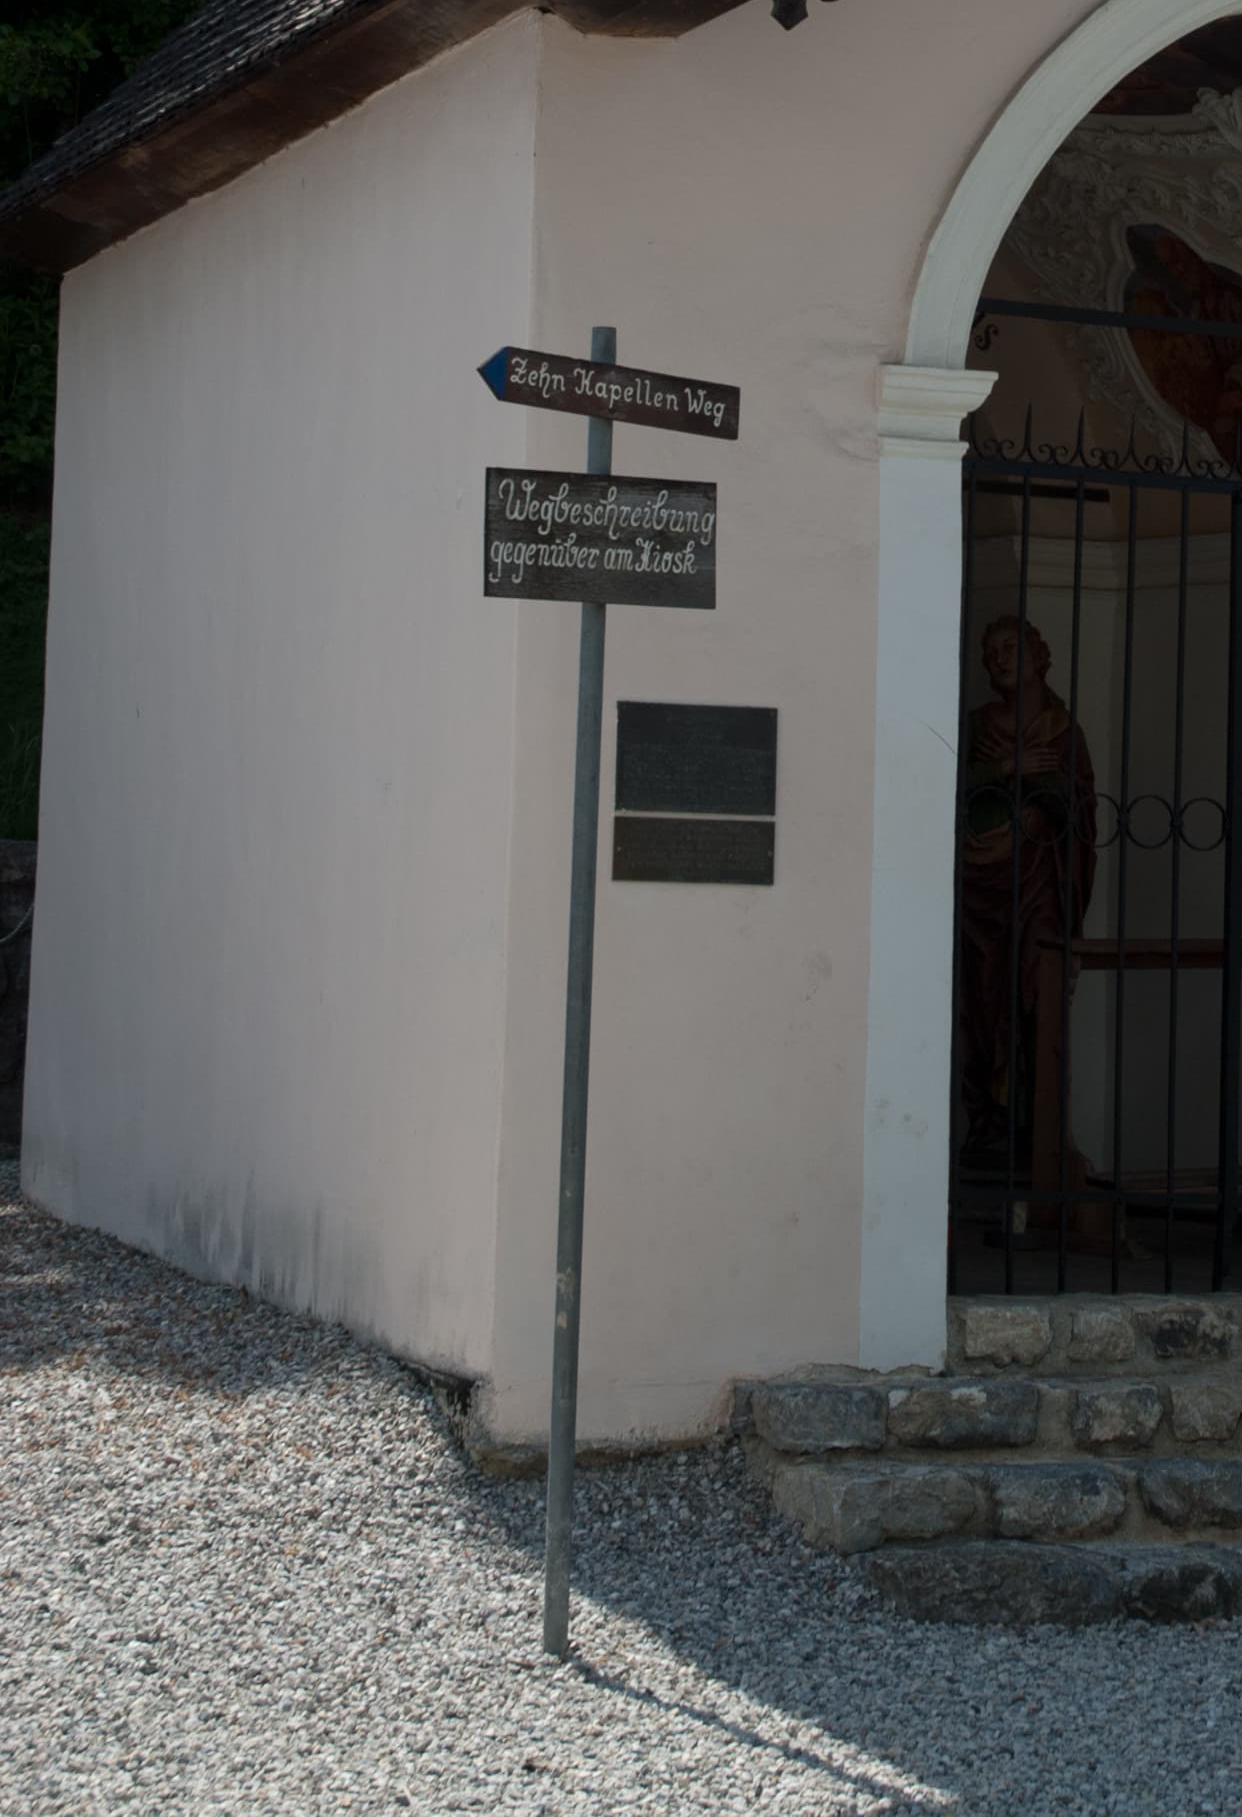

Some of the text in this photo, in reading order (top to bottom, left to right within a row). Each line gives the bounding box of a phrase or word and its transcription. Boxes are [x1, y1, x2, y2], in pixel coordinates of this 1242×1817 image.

[510, 357, 726, 427] Zehn Kapellen Weg
[498, 478, 715, 546] Wegbeschreibung
[489, 532, 697, 583] gegenüber am Kiosk
